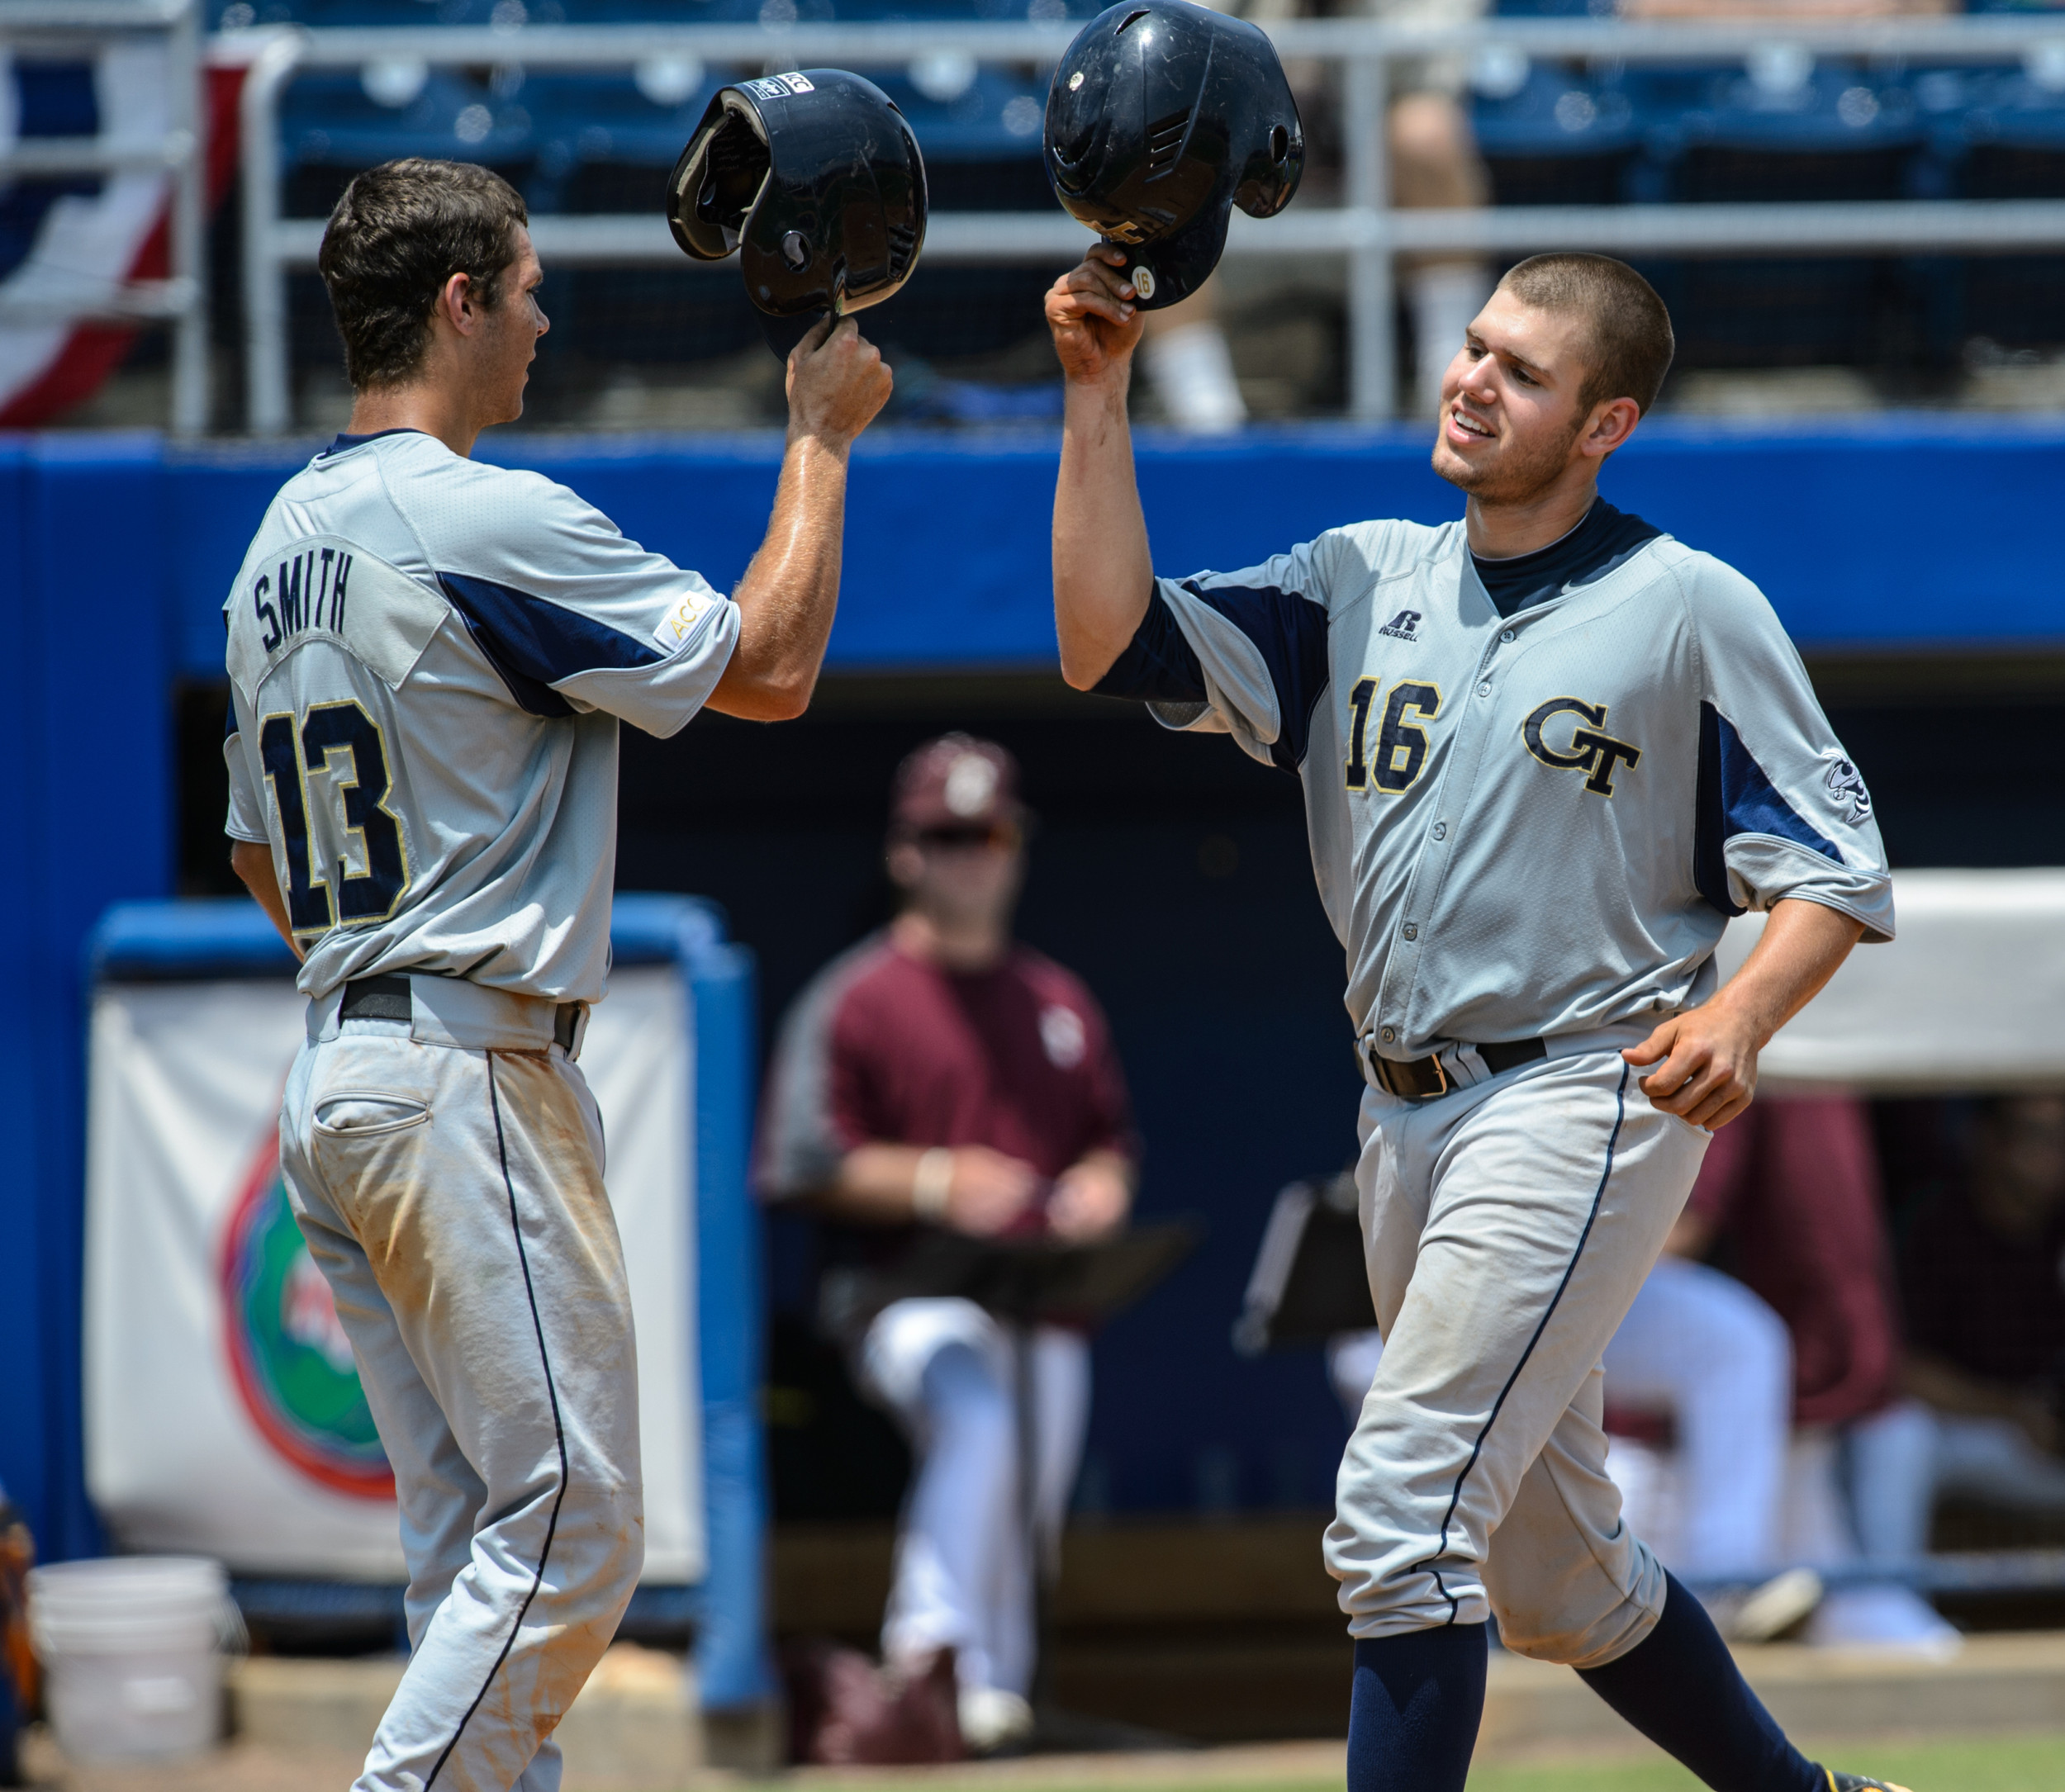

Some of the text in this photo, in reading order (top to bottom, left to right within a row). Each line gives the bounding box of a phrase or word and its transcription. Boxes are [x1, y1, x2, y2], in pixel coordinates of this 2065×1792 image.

[1136, 273, 1151, 294] 16
[254, 548, 354, 653] SMITH
[671, 598, 704, 640] ACC
[1378, 625, 1418, 642] RUSSELL
[1346, 675, 1443, 795] 16
[1522, 695, 1643, 798] GT
[259, 699, 411, 936] 13
